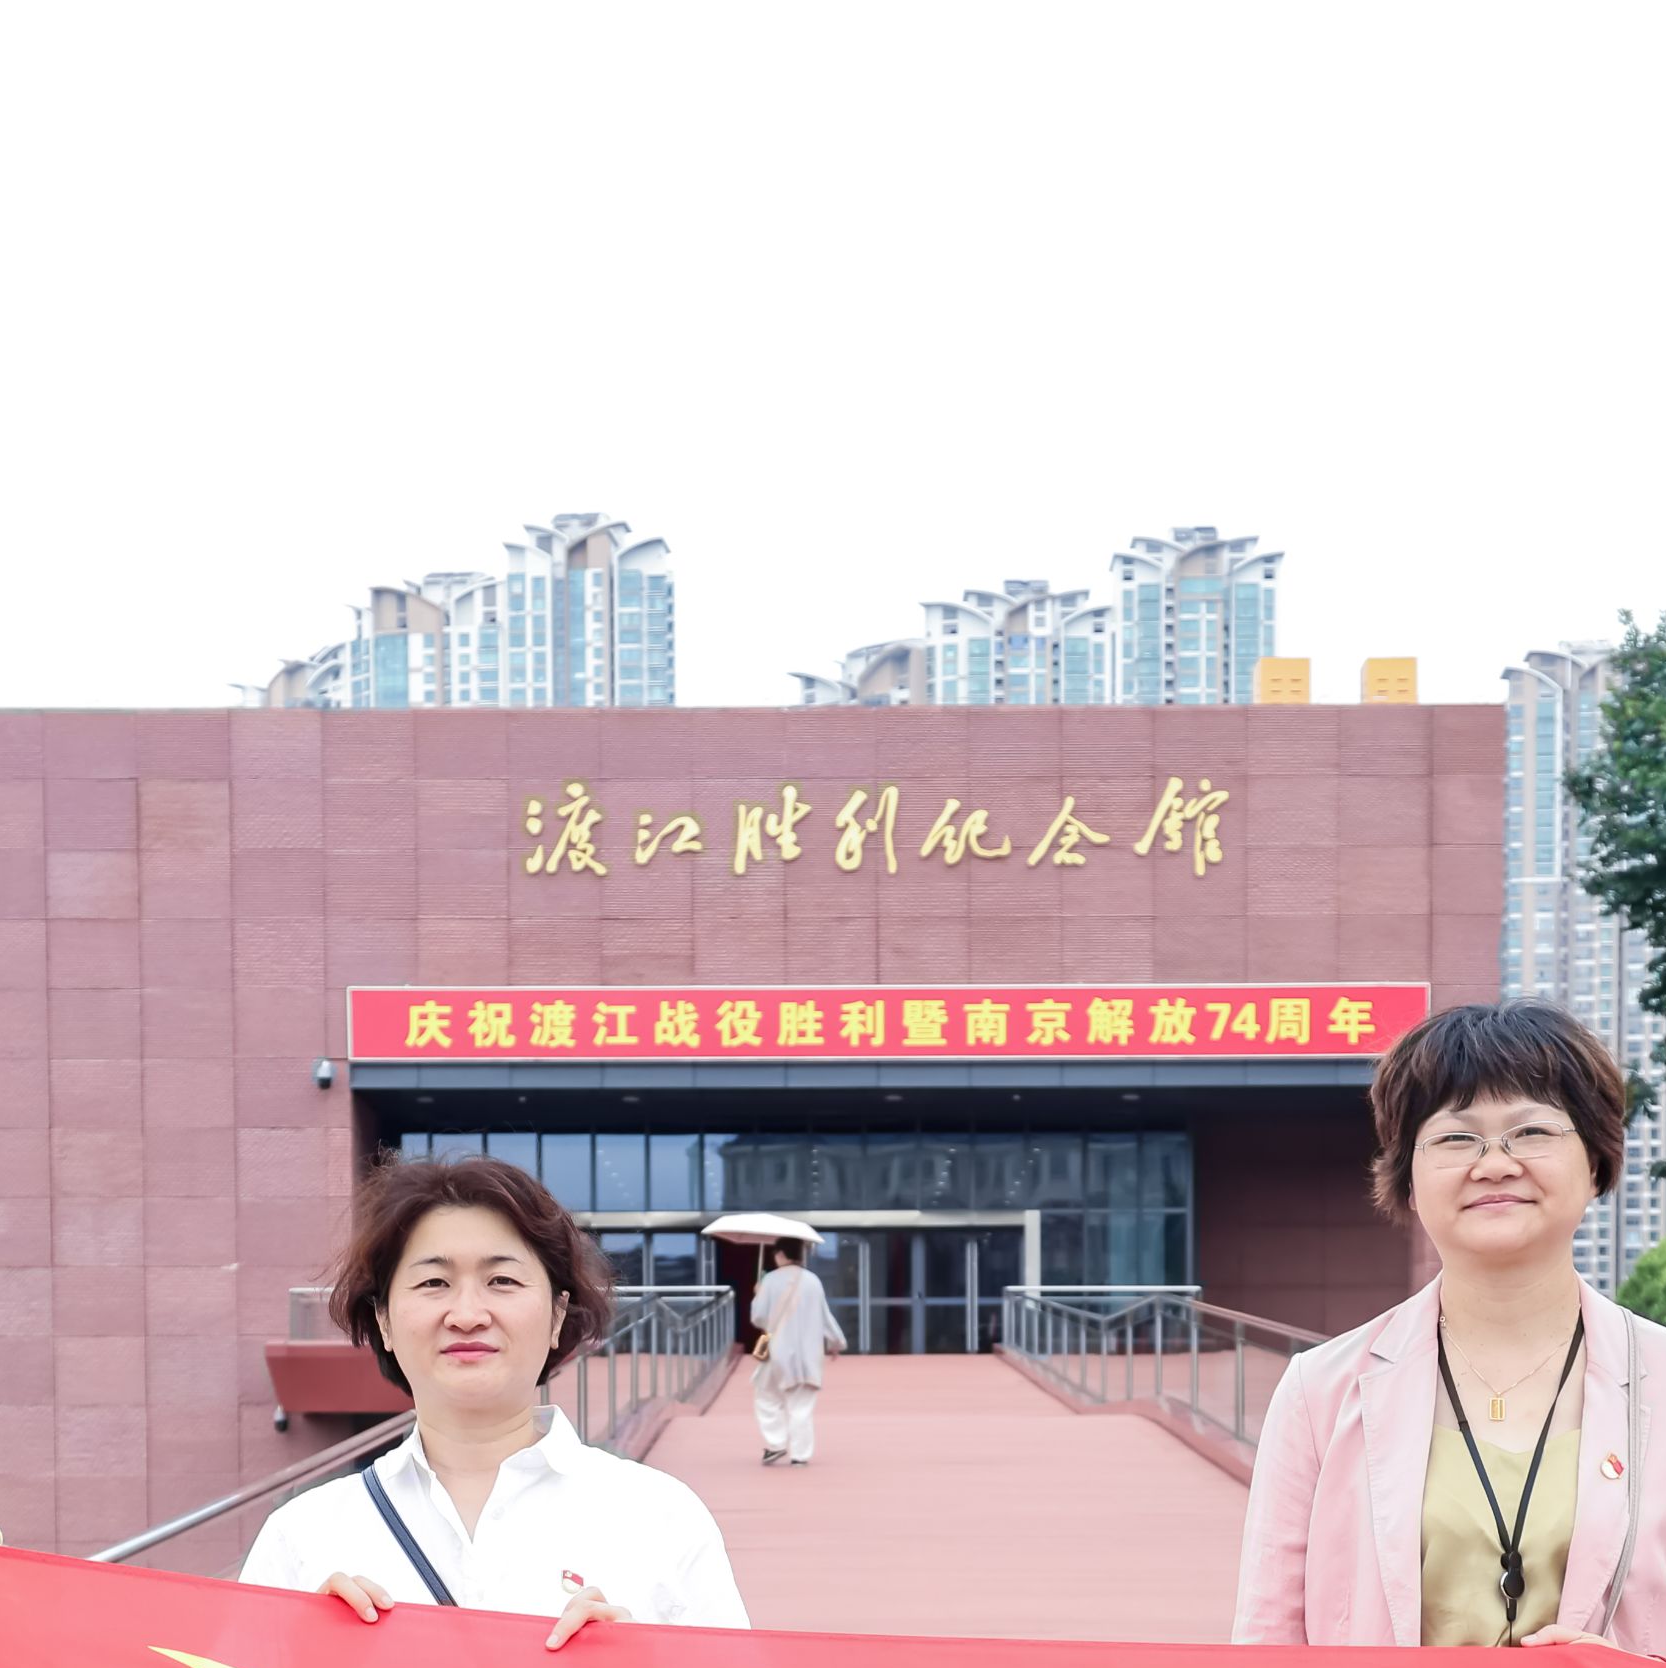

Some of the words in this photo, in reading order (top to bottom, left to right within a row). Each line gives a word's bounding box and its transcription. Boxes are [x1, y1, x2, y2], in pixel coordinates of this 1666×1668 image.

[405, 997, 1376, 1049] 庆祝渡江战役胜利暨南京解放74周年
